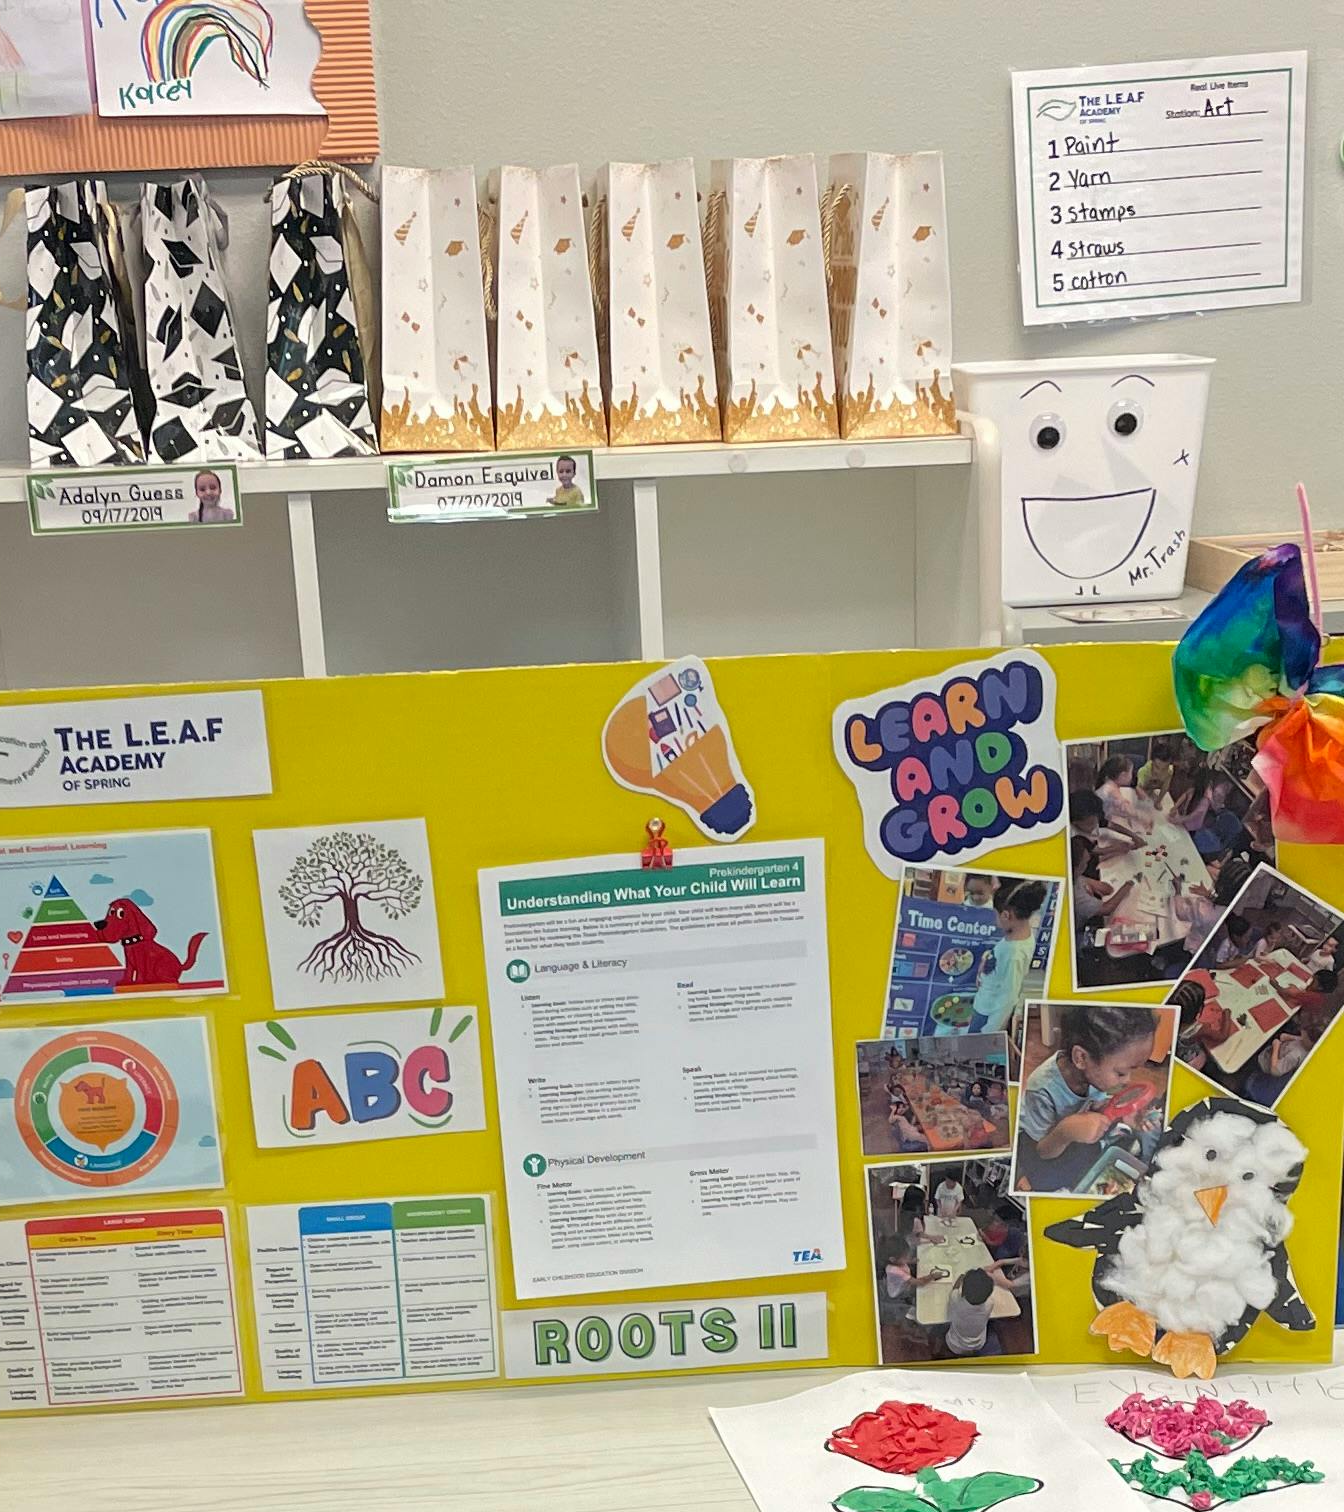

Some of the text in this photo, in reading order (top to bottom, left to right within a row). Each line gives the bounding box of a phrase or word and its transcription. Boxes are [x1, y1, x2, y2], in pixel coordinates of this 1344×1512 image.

[1079, 95, 1101, 107] THE
[1079, 106, 1122, 117] ACADEMY
[1204, 97, 1234, 117] Art
[1047, 131, 1120, 159] 1 Paint
[1048, 170, 1112, 191] 2 Yarn
[1050, 206, 1062, 224] 3
[1051, 240, 1064, 259] 4
[1053, 269, 1128, 292] 5 cotton
[415, 470, 474, 489] Damon
[59, 484, 184, 506] Adalyn Guess
[81, 506, 163, 525] 09/17/2019
[1128, 529, 1186, 586] Mr. Trash
[847, 663, 1038, 767] LEARN
[54, 717, 224, 752] THE L.E.A.F
[59, 751, 167, 775] ACADEMY
[893, 729, 1019, 801] AND
[62, 777, 132, 792] OF SPRING
[882, 767, 1056, 860] GROW
[709, 862, 799, 878] Prekindergarten 4
[506, 874, 801, 910] Understanding What Your Child Will Learn
[907, 909, 997, 936] Time Center
[534, 957, 628, 975] Language & Literacy
[290, 1045, 454, 1130] ABC
[548, 1151, 646, 1168] Physical Development
[792, 1248, 823, 1262] TEA
[533, 1307, 739, 1366] ROOTS
